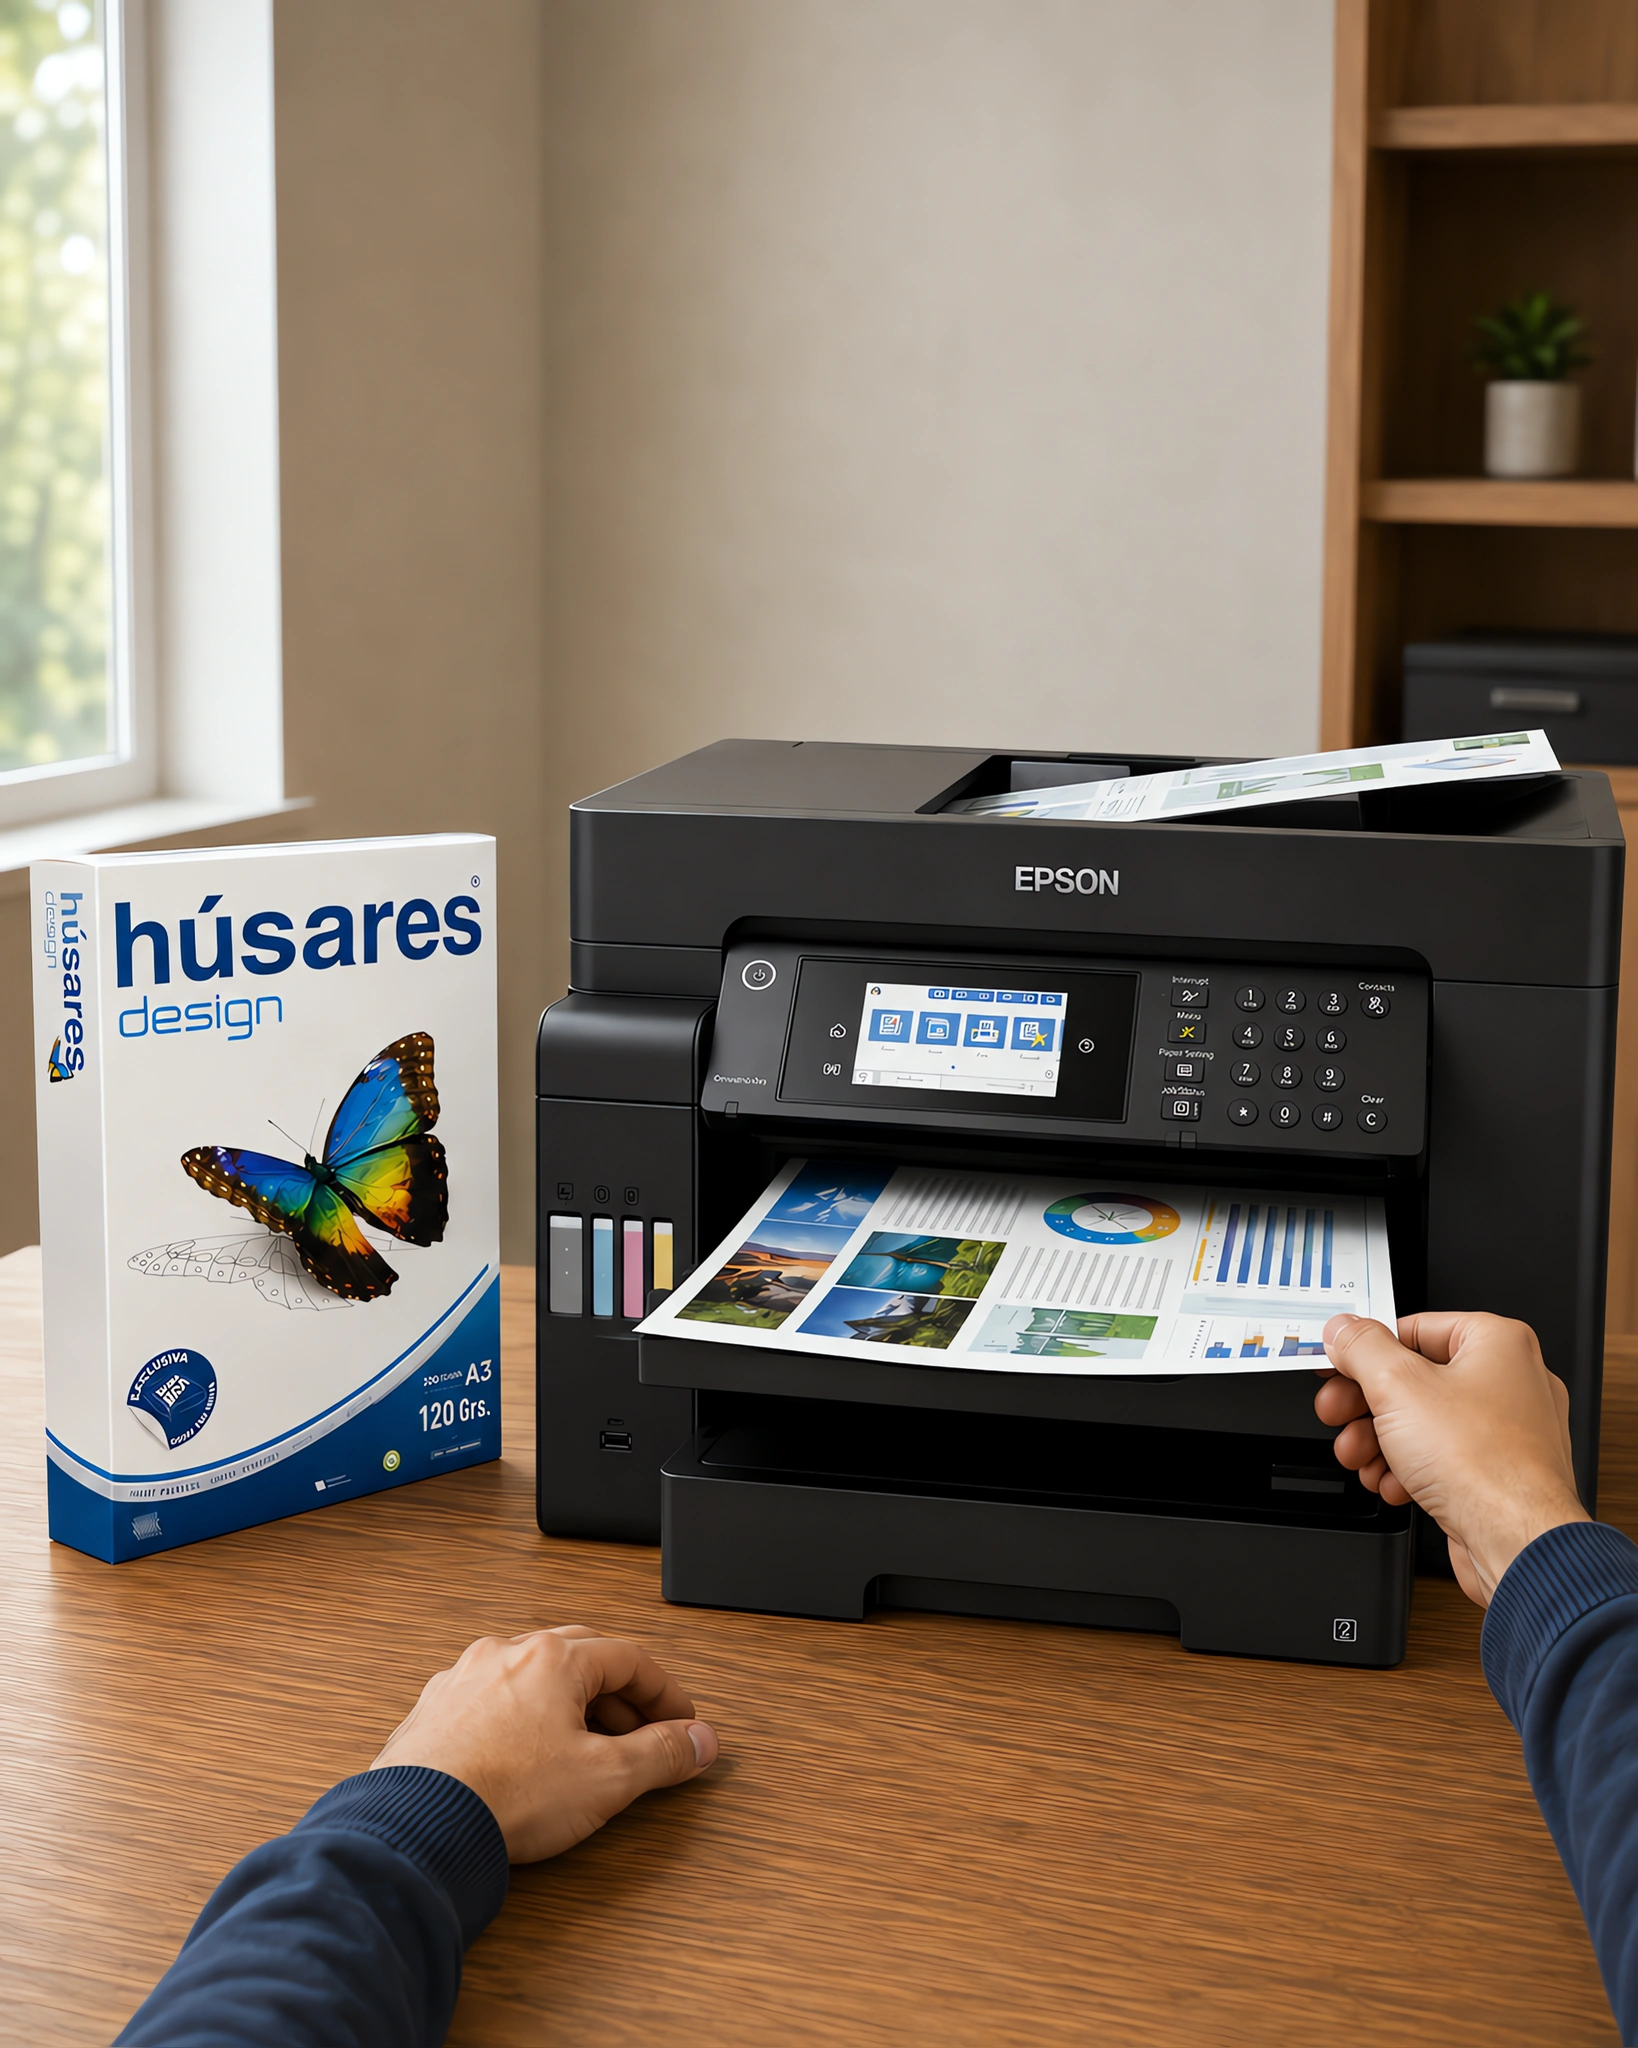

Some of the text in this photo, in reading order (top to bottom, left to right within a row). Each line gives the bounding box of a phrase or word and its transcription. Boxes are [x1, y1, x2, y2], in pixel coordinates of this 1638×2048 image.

[1015, 866, 1119, 896] EPSON
[114, 894, 482, 988] húsares
[60, 892, 88, 1072] húsares
[118, 995, 283, 1042] design
[1366, 1112, 1377, 1126] C
[464, 1359, 492, 1386] A3
[418, 1397, 491, 1432] 120 Grs.
